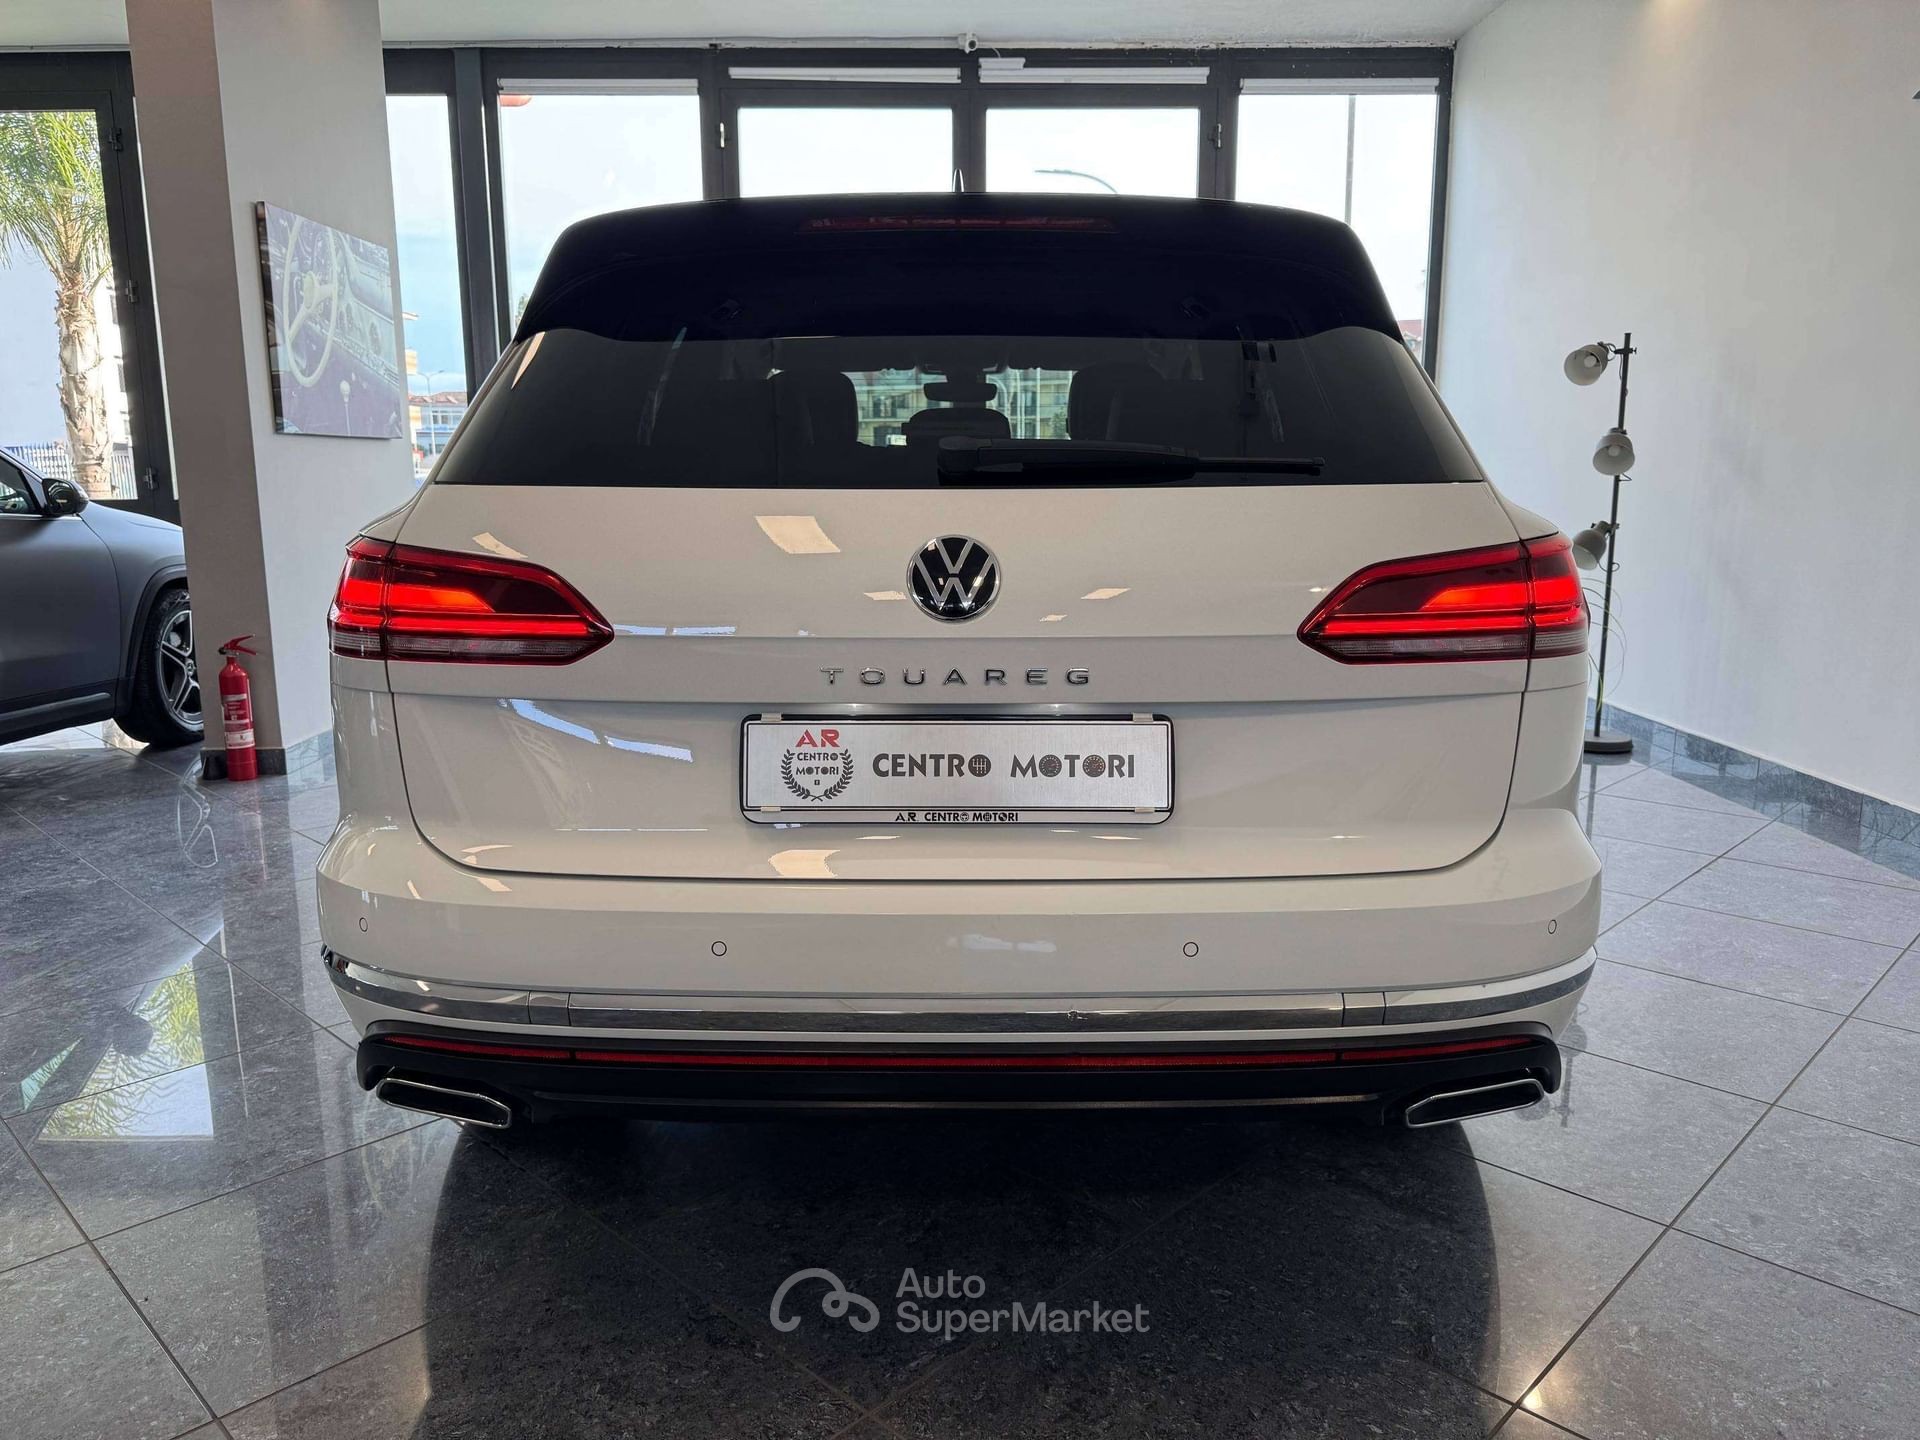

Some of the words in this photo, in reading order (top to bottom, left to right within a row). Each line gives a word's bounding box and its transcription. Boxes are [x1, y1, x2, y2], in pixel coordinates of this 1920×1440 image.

[909, 536, 998, 614] VW
[819, 666, 1089, 686] TOUAREG
[795, 729, 840, 748] AR
[796, 752, 839, 761] CENTRO
[872, 753, 992, 778] CENTRO
[1010, 754, 1135, 778] MOTORI
[795, 766, 839, 775] MOTORI
[924, 812, 970, 822] CENTRO
[972, 812, 1018, 822] MOTORI
